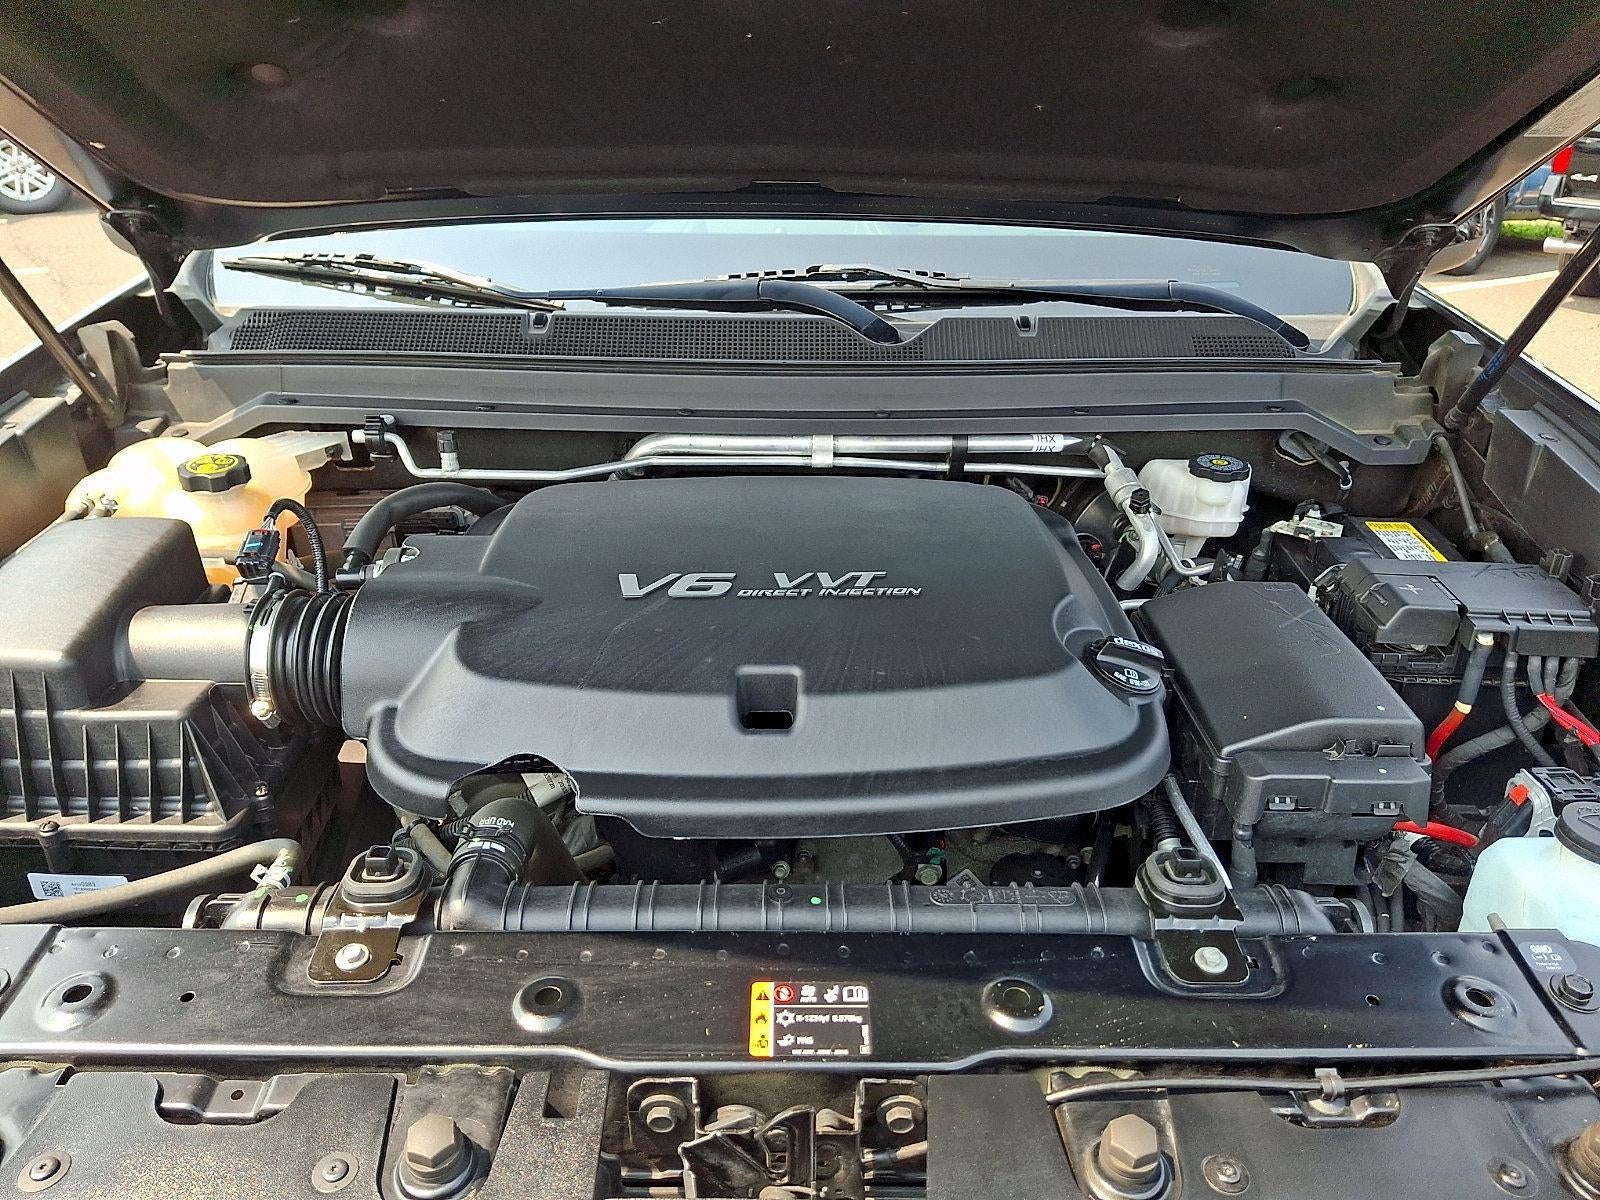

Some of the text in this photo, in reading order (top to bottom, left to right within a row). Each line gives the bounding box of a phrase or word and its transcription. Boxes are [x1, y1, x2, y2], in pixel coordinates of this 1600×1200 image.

[618, 572, 737, 599] V6
[773, 571, 887, 589] VVT
[736, 587, 922, 598] DIRECT INJECTION
